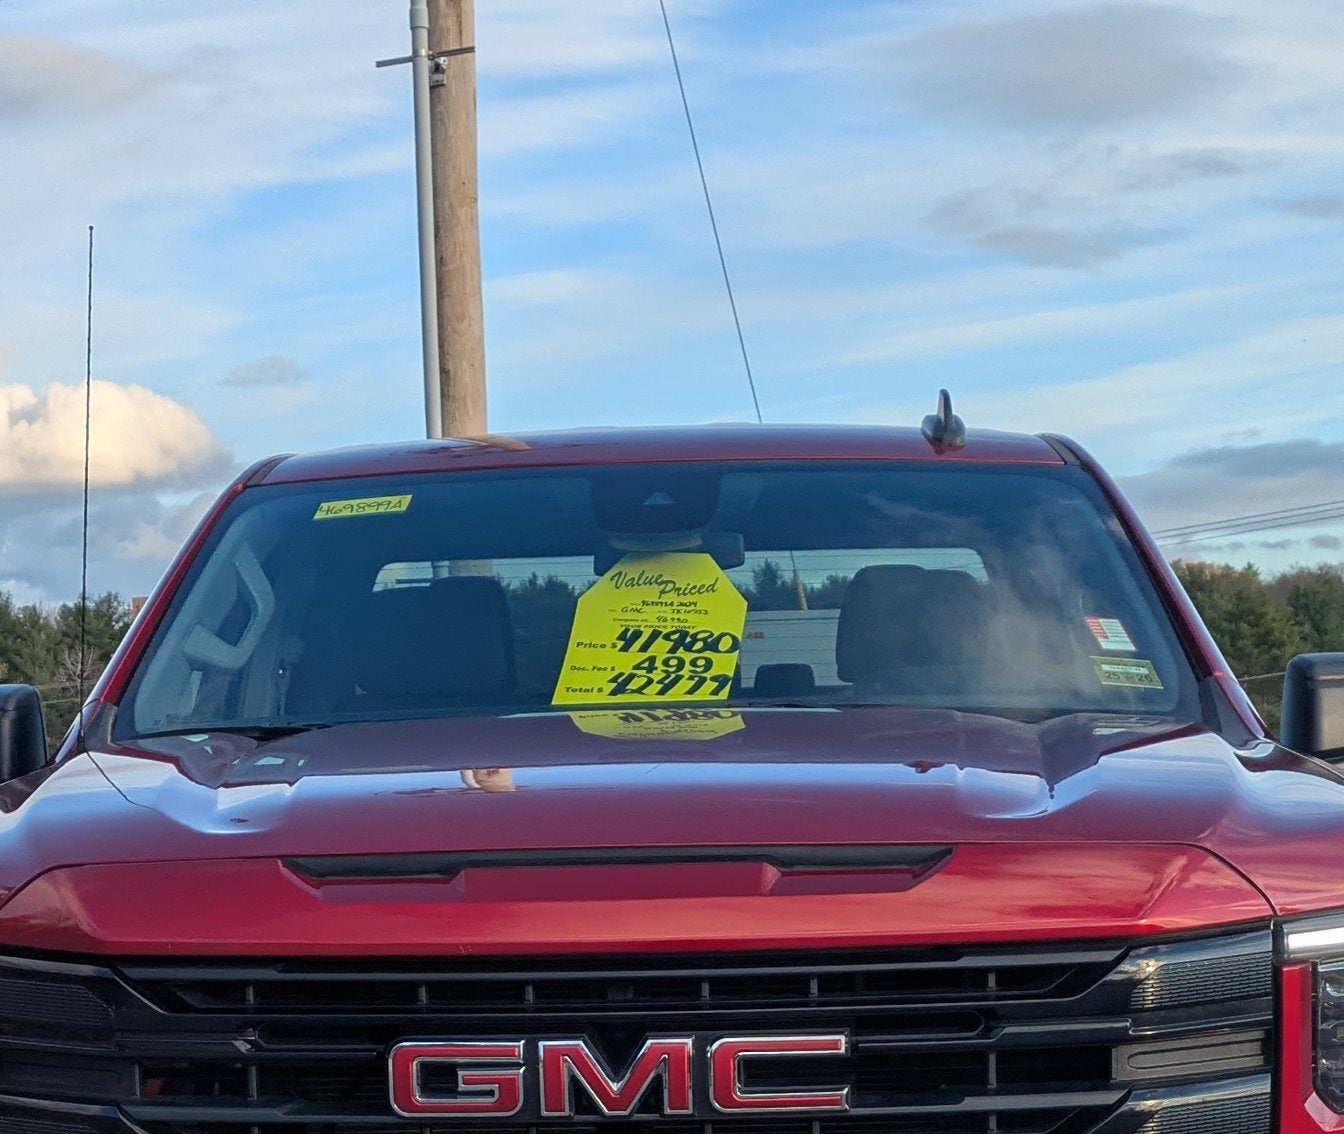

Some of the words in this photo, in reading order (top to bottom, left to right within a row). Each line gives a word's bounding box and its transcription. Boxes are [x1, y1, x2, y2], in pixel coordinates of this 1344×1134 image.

[319, 500, 402, 515] 469899A
[610, 570, 664, 589] Value
[658, 577, 719, 599] Priced
[621, 606, 644, 614] GMC
[576, 641, 606, 649] Price
[615, 628, 741, 655] 41980
[631, 655, 714, 674] 499
[388, 1034, 851, 1117] GMC
